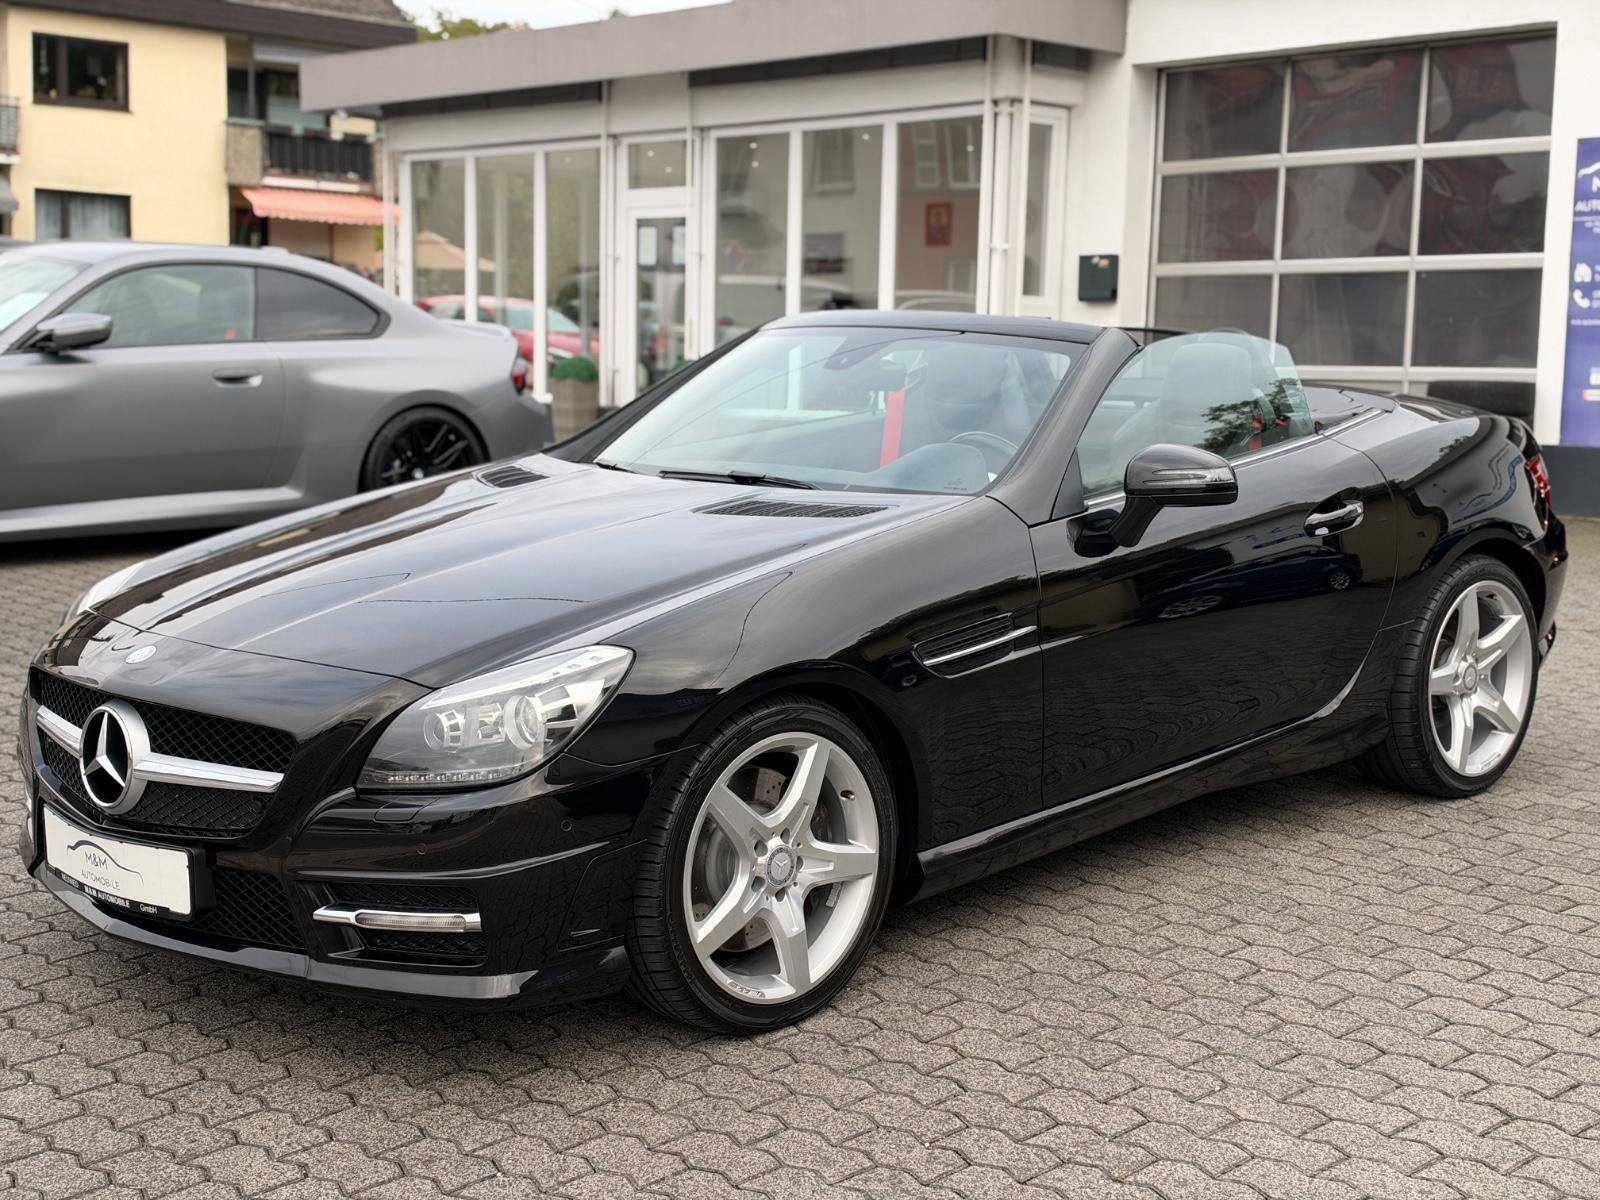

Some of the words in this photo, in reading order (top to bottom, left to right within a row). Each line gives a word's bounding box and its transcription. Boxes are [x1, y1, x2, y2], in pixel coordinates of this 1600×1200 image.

[85, 851, 108, 870] M&M
[81, 869, 120, 891] AUTOMOBILE
[97, 892, 131, 909] AUTOMOBILE
[139, 904, 158, 915] GmbH
